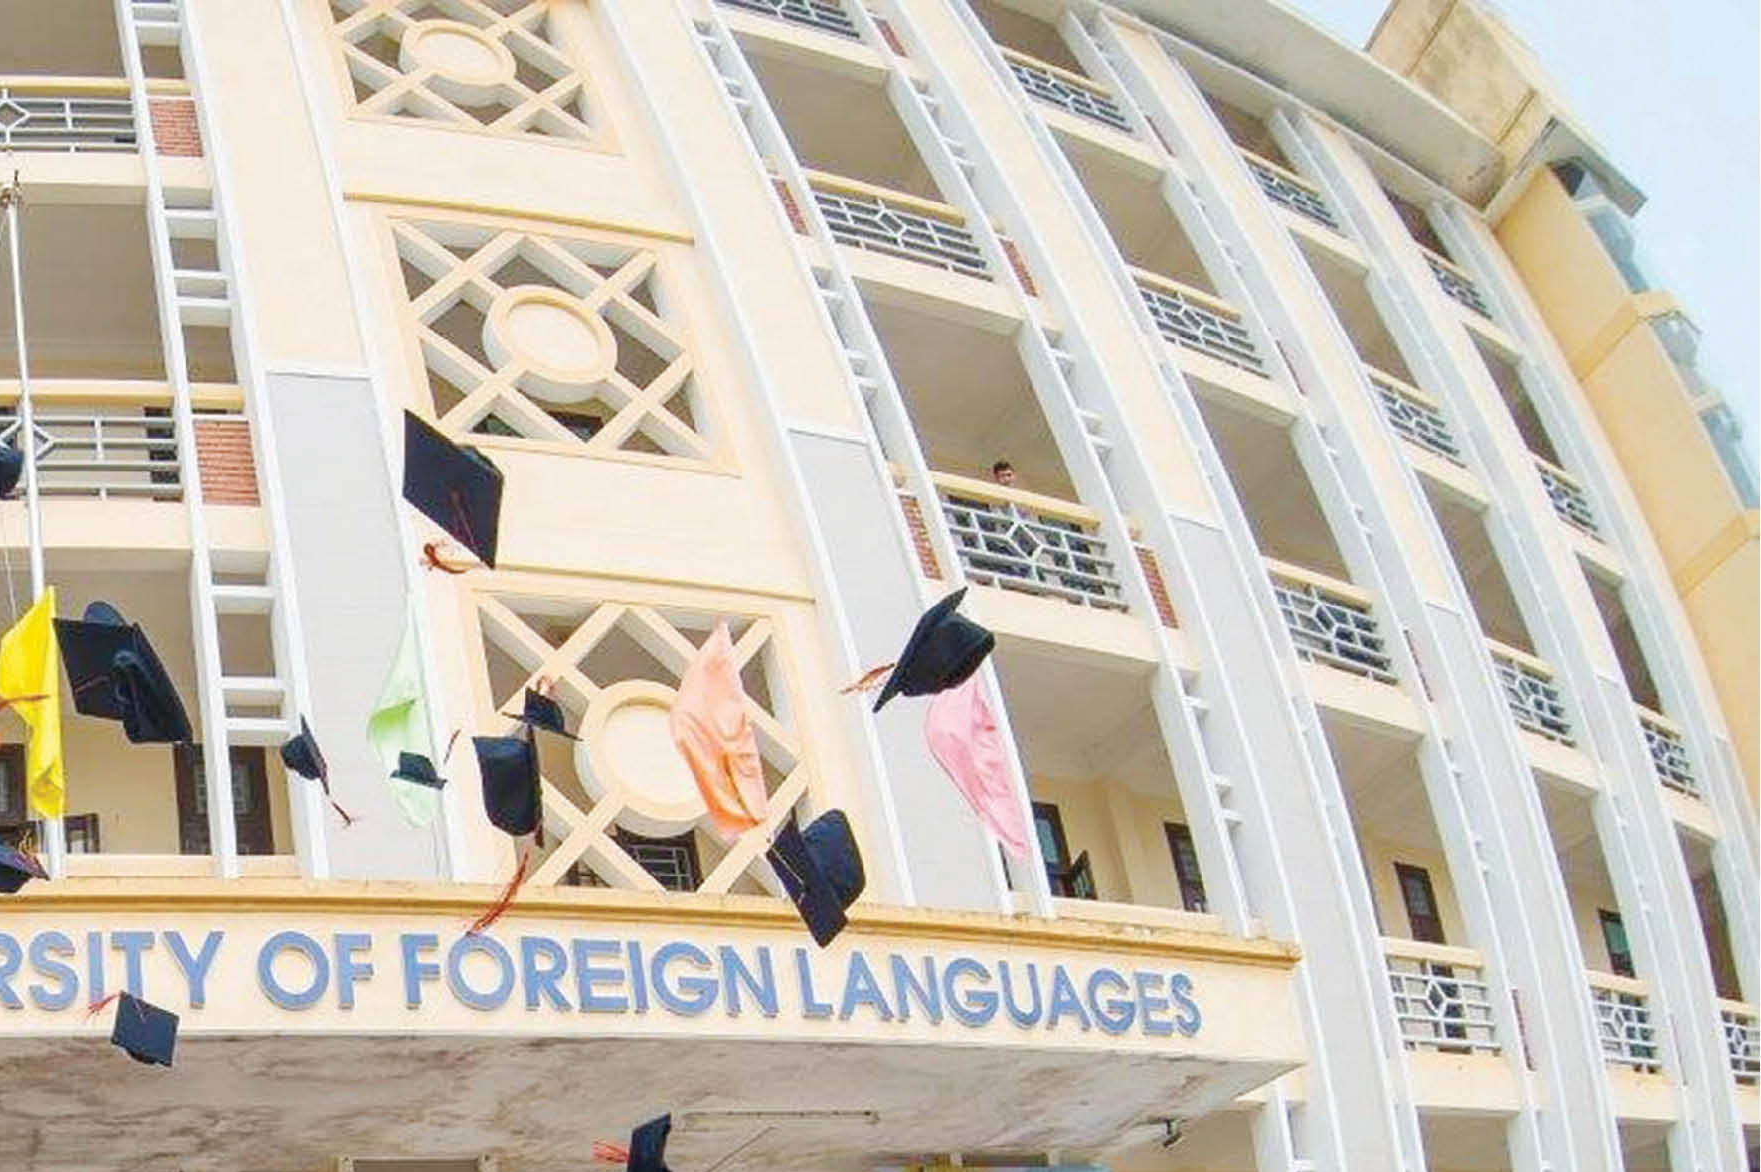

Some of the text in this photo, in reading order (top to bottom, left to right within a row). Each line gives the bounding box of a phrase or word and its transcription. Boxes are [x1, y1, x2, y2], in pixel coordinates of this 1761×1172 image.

[256, 931, 373, 1010] OF
[400, 933, 779, 1017] FOREIGN
[795, 949, 1201, 1036] LANGUAGES
